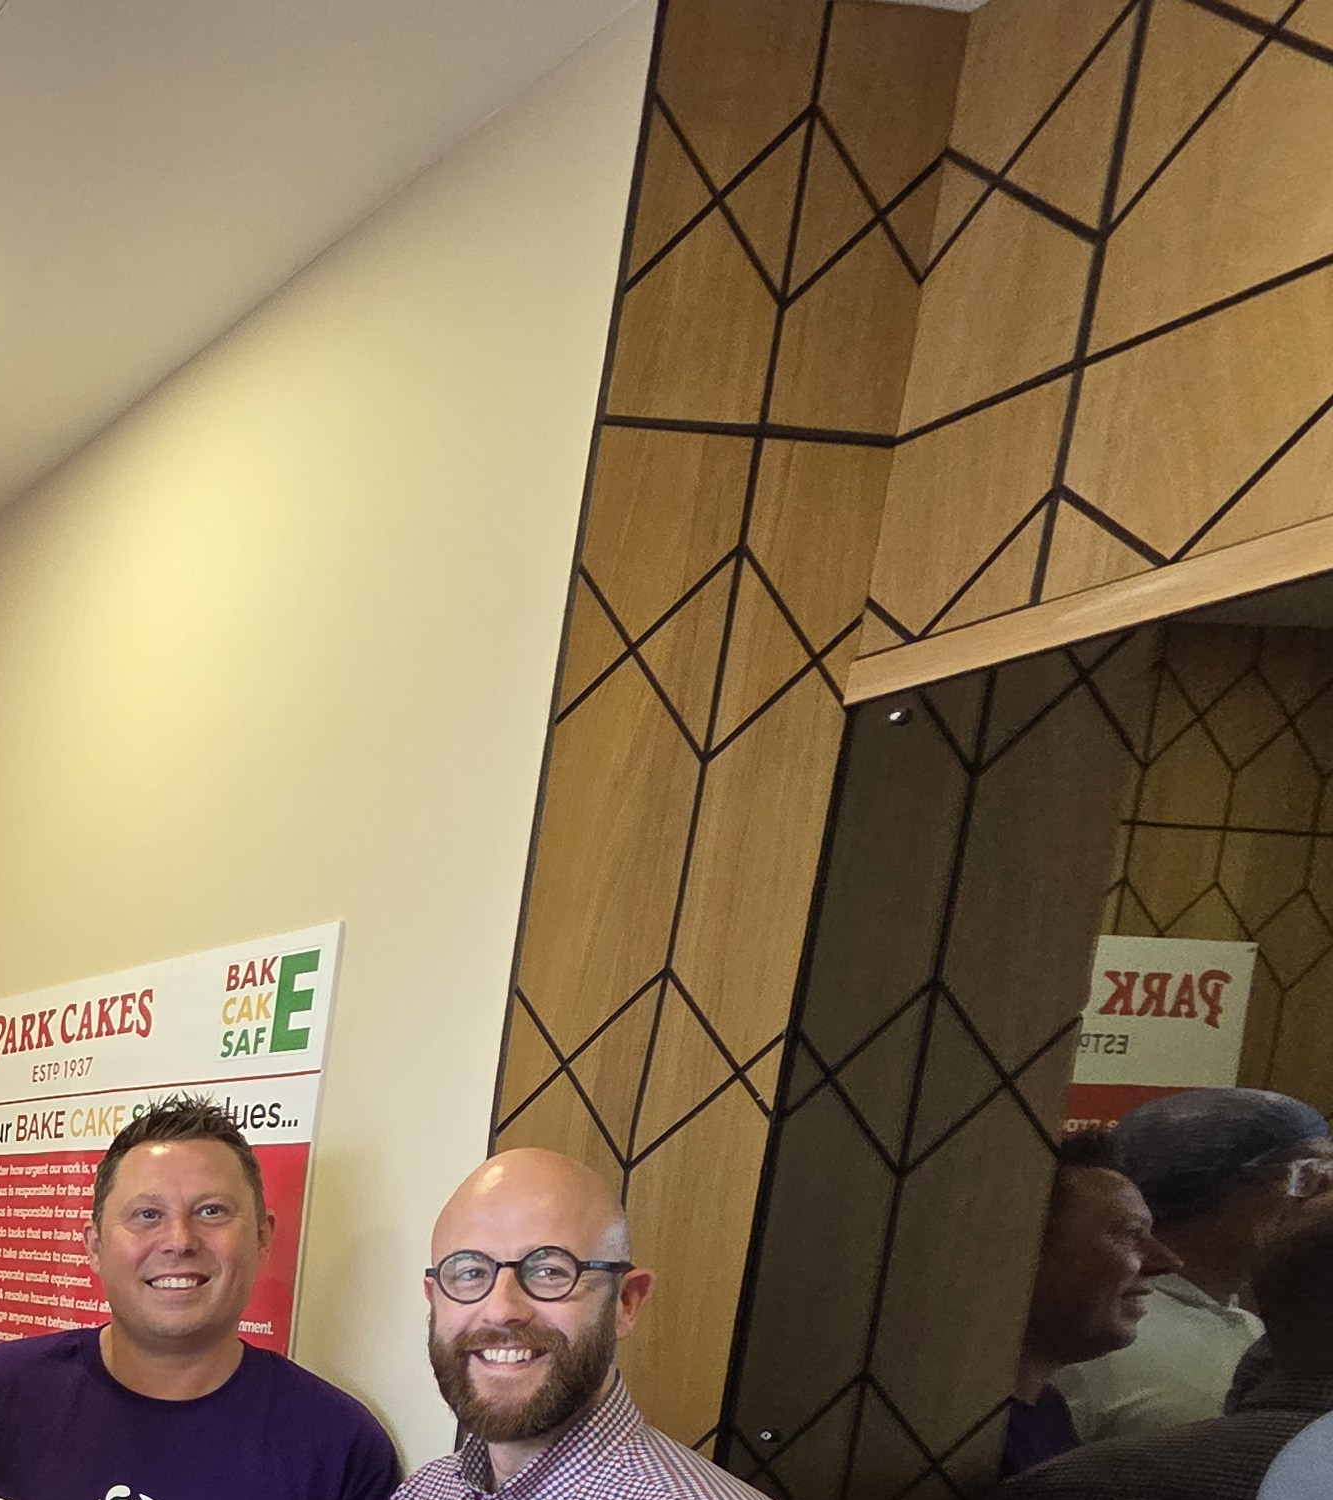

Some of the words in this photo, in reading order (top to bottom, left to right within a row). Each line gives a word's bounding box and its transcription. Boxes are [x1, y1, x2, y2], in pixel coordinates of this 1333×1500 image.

[60, 988, 155, 1044] CAKES
[63, 1056, 94, 1079] 1937
[15, 1110, 66, 1142] BAKE
[70, 1105, 126, 1138] CAKE
[226, 1096, 299, 1131] lues...
[56, 1184, 67, 1196] for
[68, 1184, 81, 1196] the
